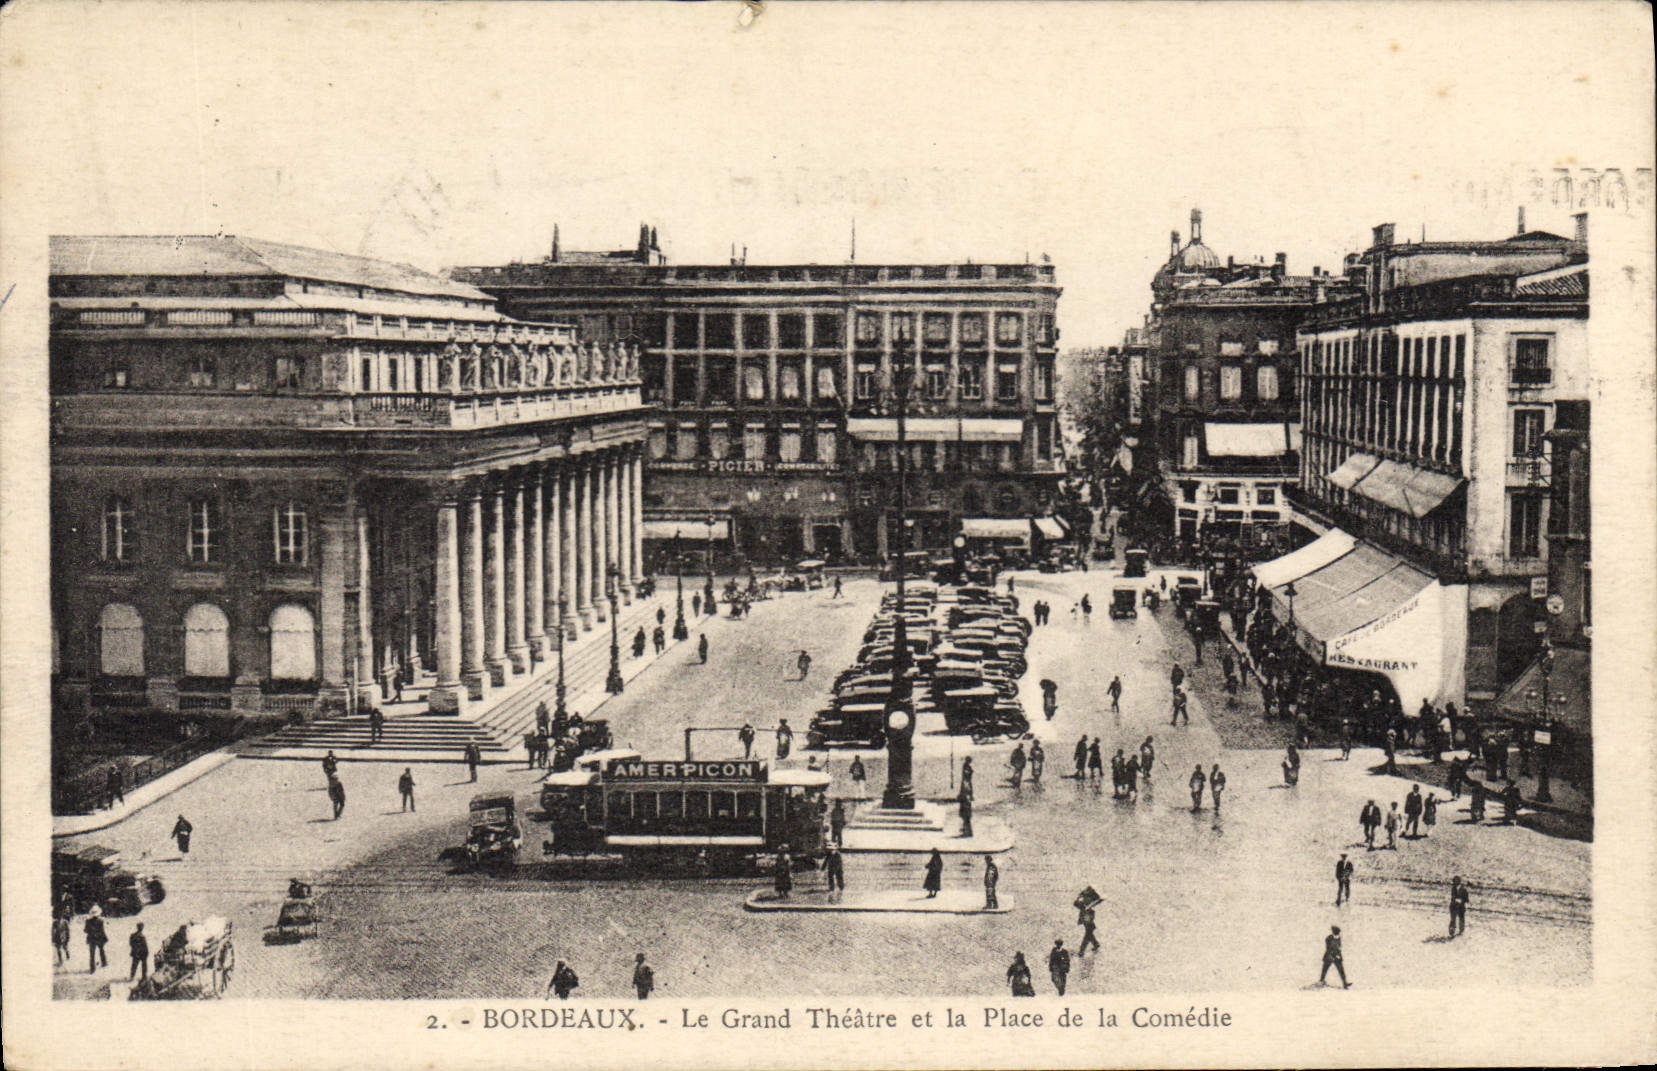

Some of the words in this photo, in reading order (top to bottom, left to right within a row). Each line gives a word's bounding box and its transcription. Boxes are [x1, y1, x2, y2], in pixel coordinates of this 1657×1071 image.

[1328, 653, 1419, 671] RESTAURANT
[614, 763, 677, 777] AMER
[681, 763, 753, 777] PICON
